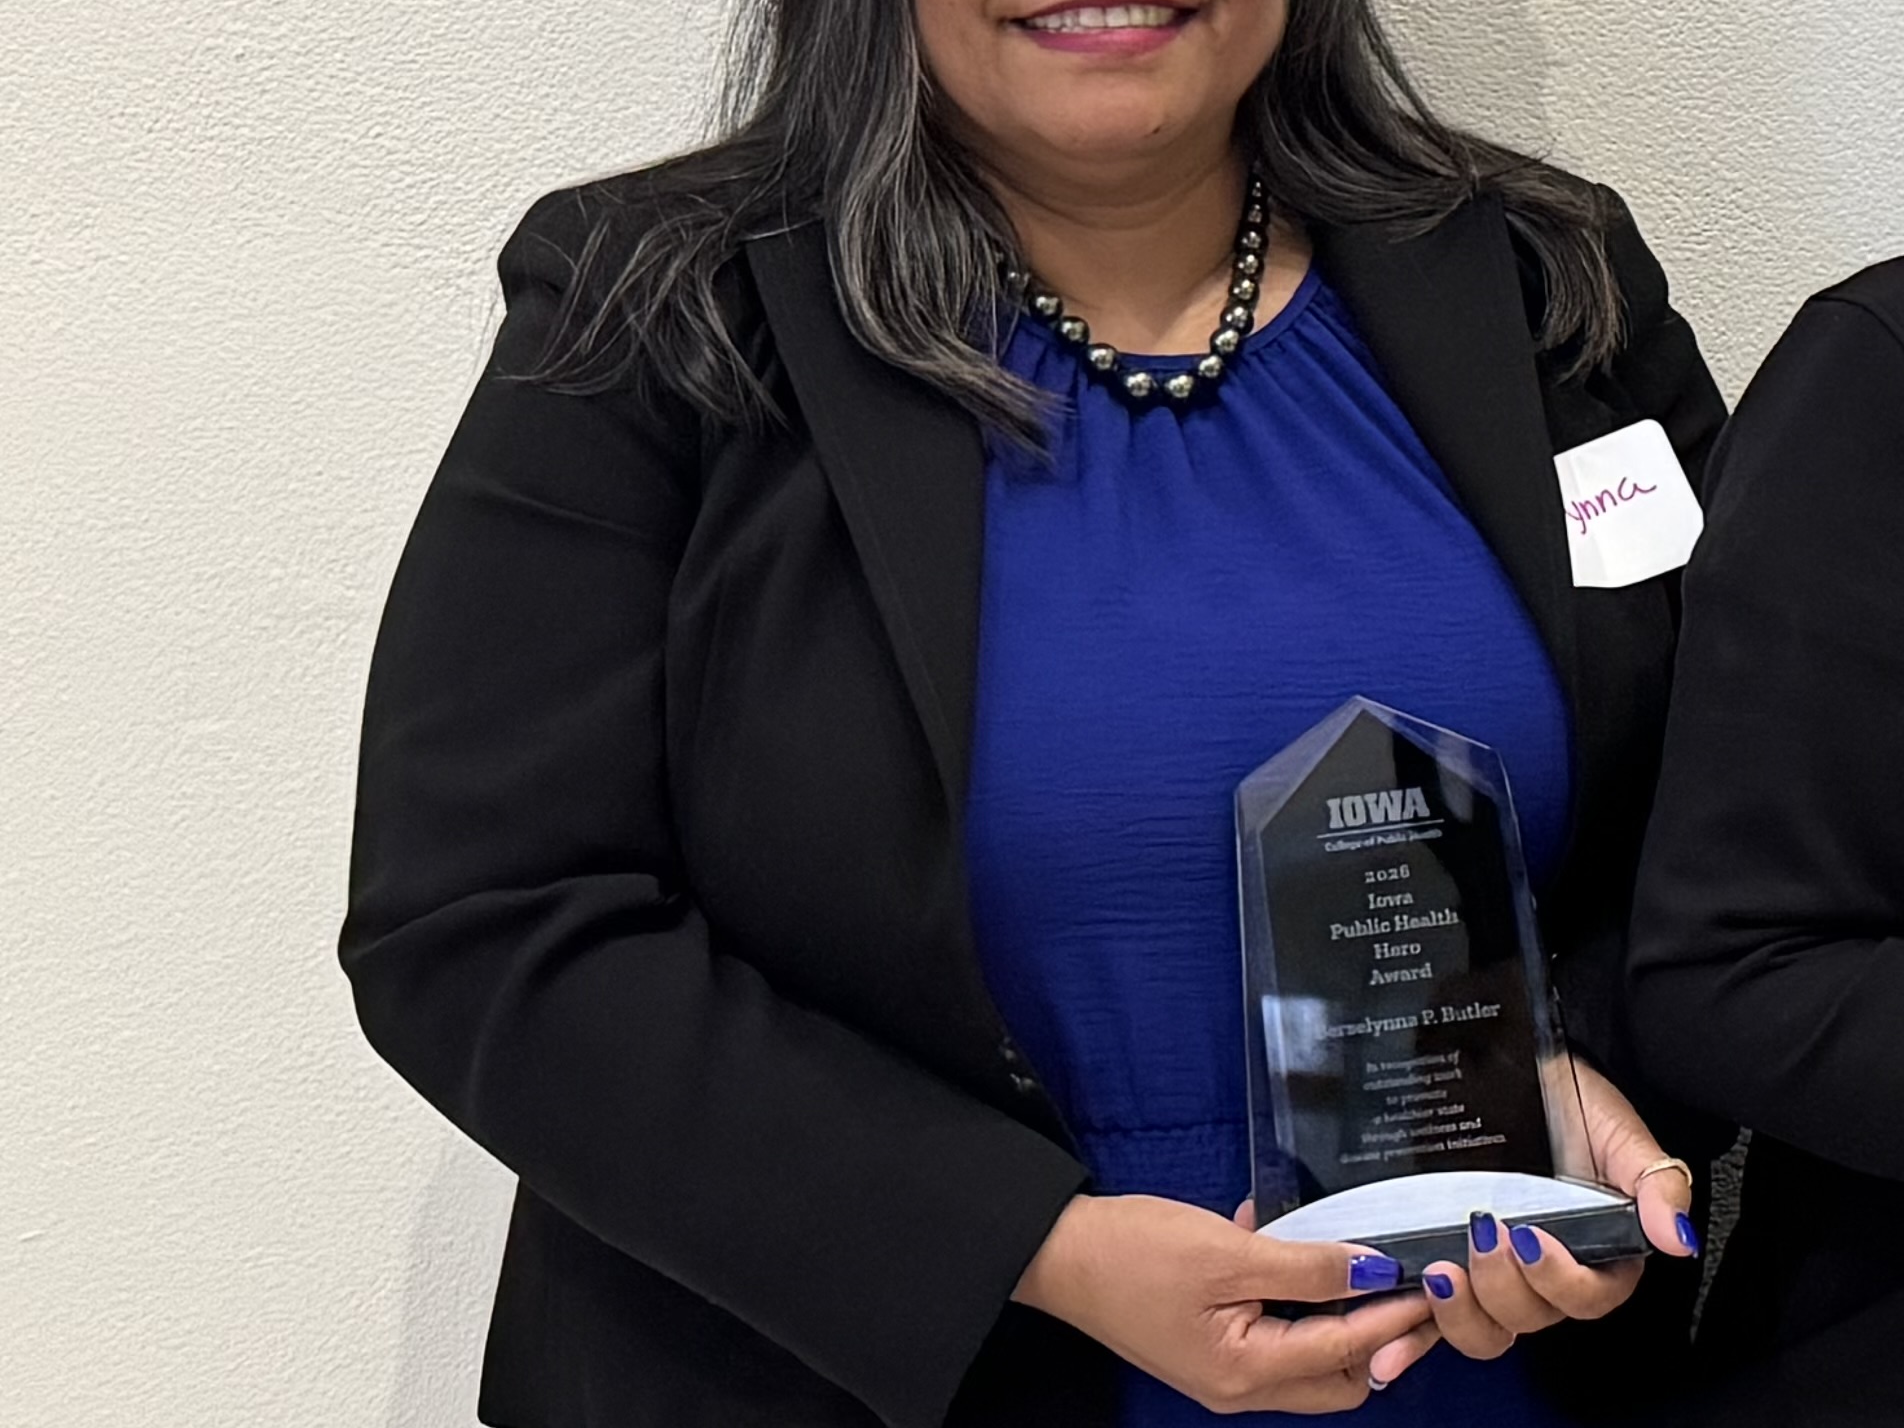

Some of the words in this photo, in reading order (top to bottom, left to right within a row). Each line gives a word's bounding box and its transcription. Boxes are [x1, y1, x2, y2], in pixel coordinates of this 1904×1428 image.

[1326, 786, 1431, 830] IOWA
[1367, 891, 1414, 910] Iowa
[1329, 917, 1391, 941] Public
[1393, 907, 1460, 933] Health
[1373, 941, 1422, 960] Hero
[1368, 962, 1434, 986] Award
[1421, 1009, 1439, 1026] P.
[1440, 1001, 1502, 1023] Butler
